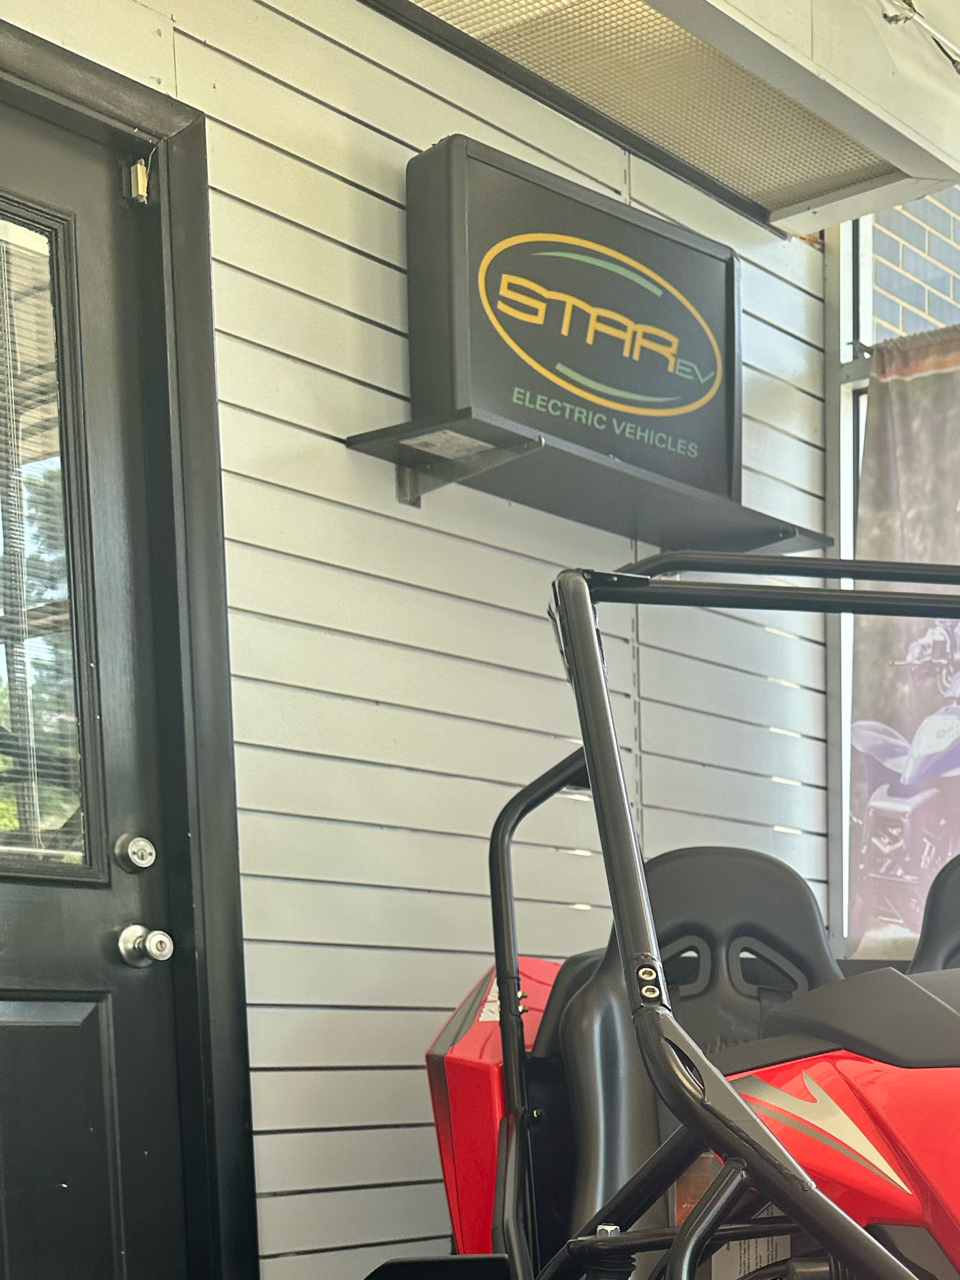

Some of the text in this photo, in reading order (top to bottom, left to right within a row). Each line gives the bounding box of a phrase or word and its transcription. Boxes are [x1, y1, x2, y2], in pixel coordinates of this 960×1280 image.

[497, 273, 715, 384] STAR EV
[512, 387, 699, 458] ELECTRIC VEHICLES
